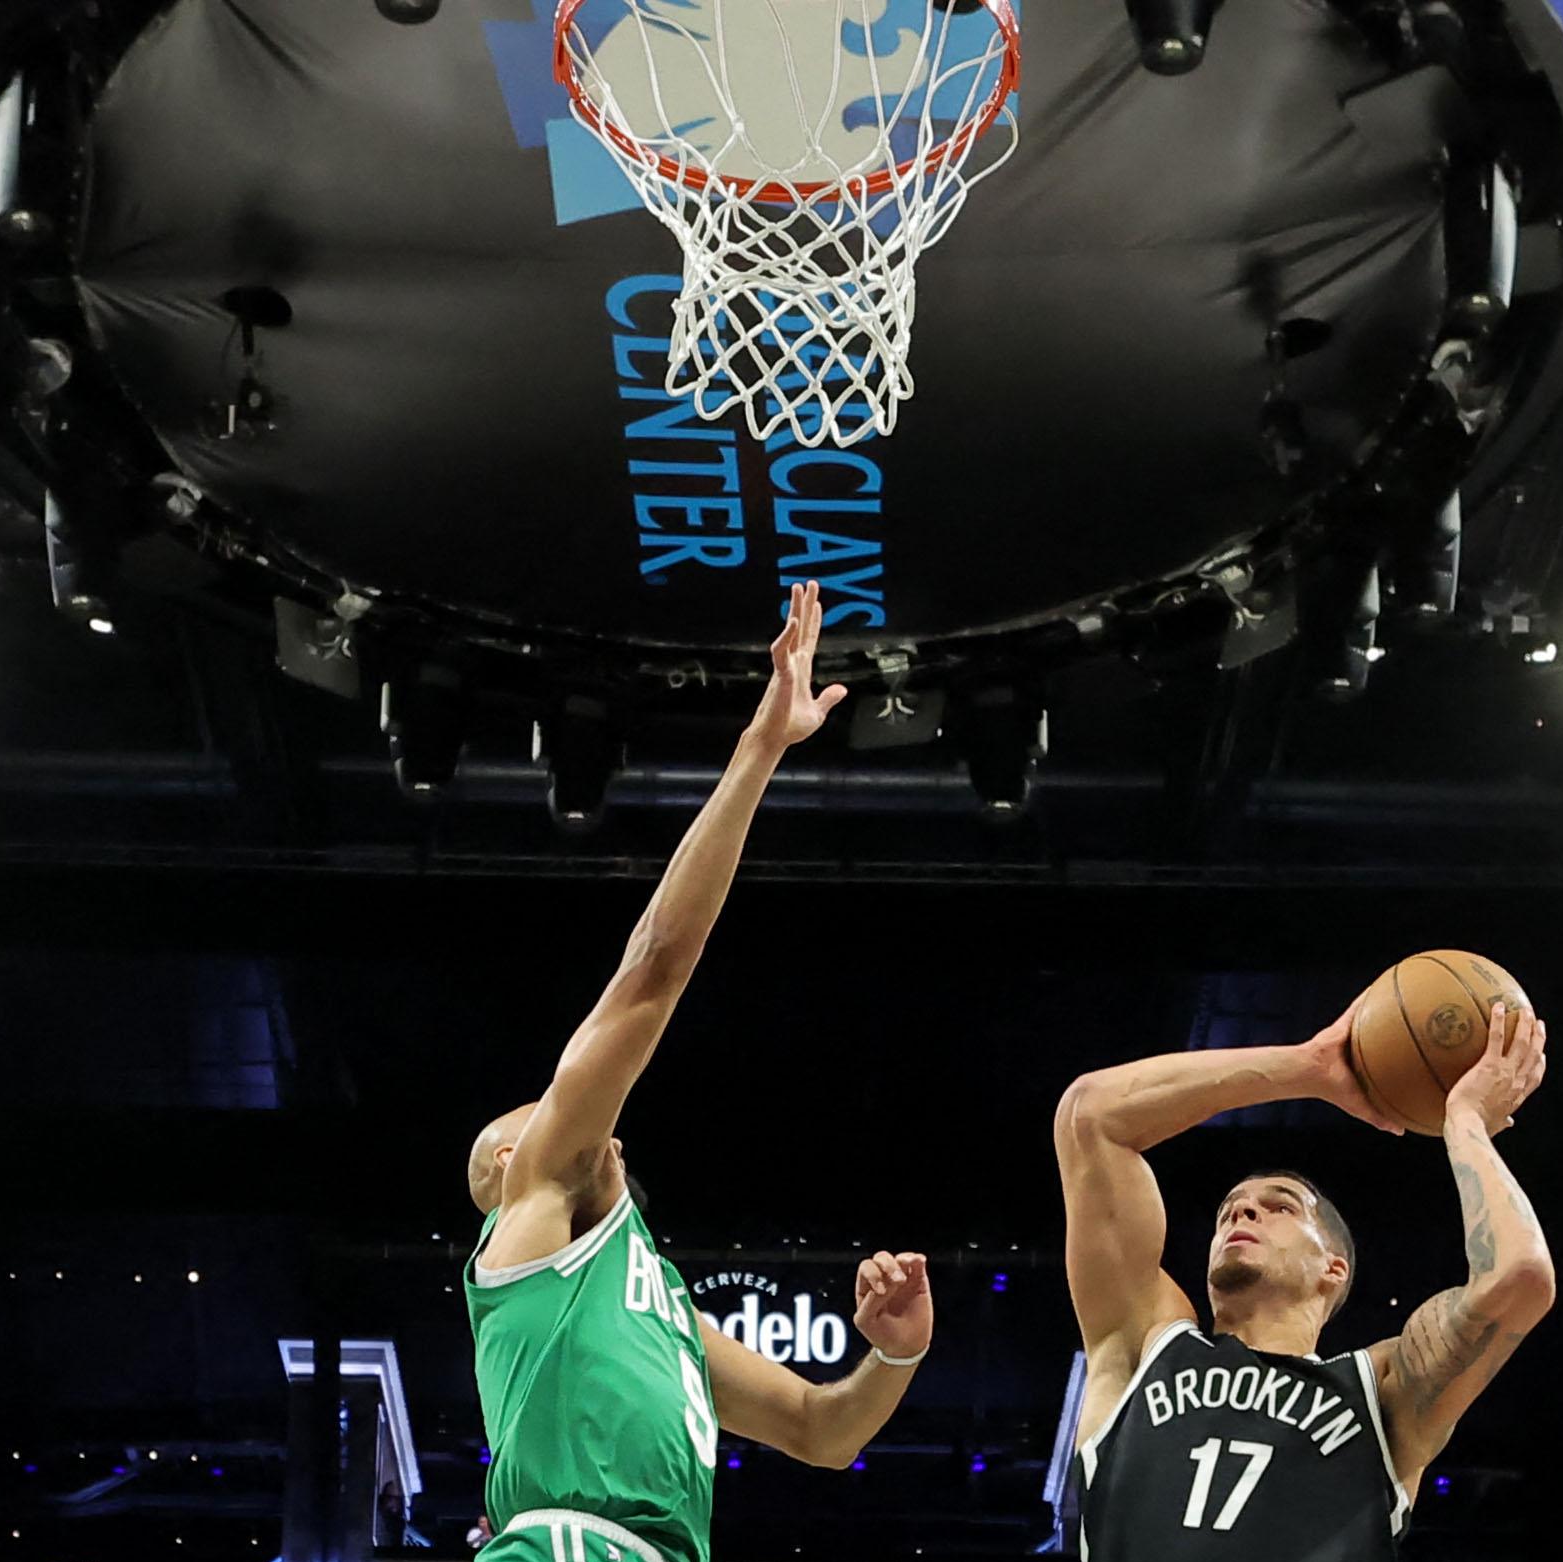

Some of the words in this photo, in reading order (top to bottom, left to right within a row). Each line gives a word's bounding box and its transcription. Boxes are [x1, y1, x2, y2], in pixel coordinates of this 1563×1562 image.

[605, 274, 747, 576] CENTER
[693, 1271, 778, 1297] CERVEZA
[1143, 1365, 1363, 1457] BROOKLYN
[1182, 1437, 1274, 1531] 17
